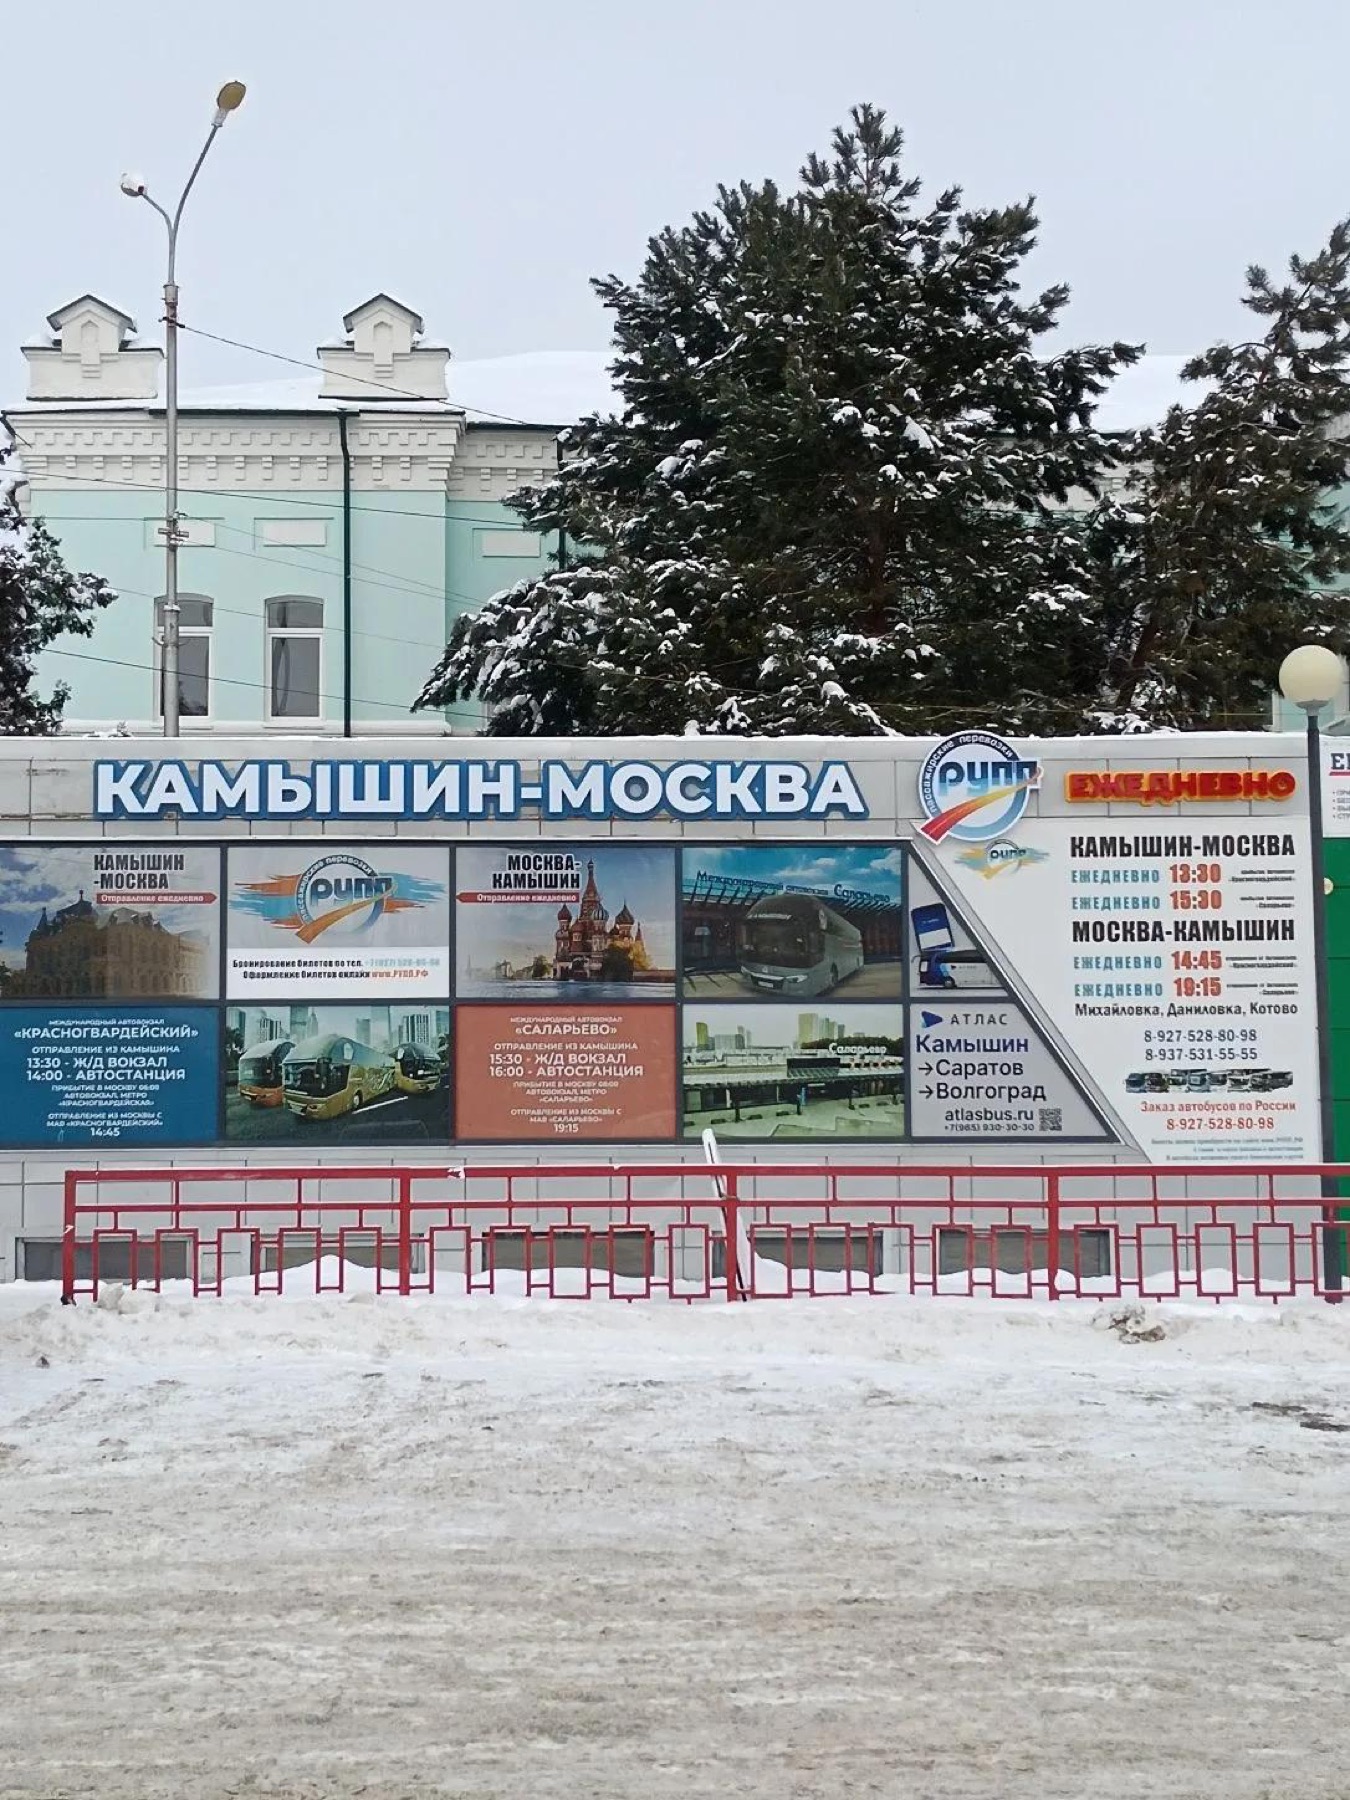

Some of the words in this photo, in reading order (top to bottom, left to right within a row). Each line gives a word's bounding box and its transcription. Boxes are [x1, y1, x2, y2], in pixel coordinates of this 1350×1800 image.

[96, 763, 862, 815] КАМЫШИН-МОСКВА
[1068, 772, 1296, 802] ЕЖЕДНЕВНО
[1070, 835, 1295, 857] КАМЫШИН-МОСКВА
[94, 854, 184, 870] КАМЫШИН
[508, 854, 581, 870] МОСКВА-
[1071, 869, 1160, 884] ЕЖЕДНЕВНО
[1170, 863, 1222, 884] 13:30
[94, 873, 169, 889] -МОСКВА
[492, 873, 580, 889] КАМЫШИН
[1072, 896, 1161, 911] ЕЖЕДНЕВНО
[1170, 890, 1222, 910] 15:30
[1072, 919, 1295, 942] МОСКВА-КАМЫШИН
[233, 959, 297, 969] Бронирование
[297, 959, 333, 967] билетов
[1073, 956, 1162, 971] ЕЖЕДНЕВНО
[1171, 950, 1222, 970] 14:45
[243, 971, 300, 980] Оформление
[301, 971, 337, 979] билетов
[1074, 983, 1163, 998] ЕЖЕДНЕВНО
[1174, 977, 1222, 997] 19:15
[1075, 1003, 1164, 1018] Михайловка,
[1167, 1003, 1246, 1018] Даниловка,
[1250, 1002, 1298, 1015] Котово
[951, 1013, 1008, 1025] АТЛАС
[14, 1025, 199, 1039] «КРАСНОГВАРДЕЙСКИЙ»
[515, 1024, 617, 1036] «САЛАРЬЕВО»
[1144, 1029, 1257, 1042] 8-927-528-80-98
[32, 1046, 103, 1054] ОТПРАВЛЕНИЕ
[494, 1043, 563, 1051] ОТПРАВЛЕНИЕ
[916, 1034, 1029, 1053] Камышин
[490, 1053, 523, 1064] 15:30
[534, 1053, 565, 1065] Ж/Д
[569, 1053, 626, 1064] ВОКЗАЛ
[1145, 1048, 1258, 1060] 8-937-531-55-55
[27, 1057, 61, 1068] 13:30
[73, 1056, 104, 1069] Ж/Д
[108, 1057, 168, 1068] ВОКЗАЛ
[936, 1059, 1024, 1079] Саратов
[26, 1070, 63, 1081] 14:00
[76, 1069, 186, 1081] АВТОСТАНЦИЯ
[490, 1066, 524, 1077] 16:00
[536, 1066, 644, 1078] АВТОСТАНЦИЯ
[937, 1083, 1047, 1103] Волгоград
[1141, 1101, 1175, 1112] Заказ
[1178, 1101, 1236, 1114] автобусов
[1239, 1103, 1252, 1111] по
[1255, 1100, 1296, 1111] России
[945, 1108, 1034, 1121] atlasbus.ru
[554, 1124, 579, 1133] 19:15
[1166, 1117, 1275, 1131] 8-927-528-80-98
[91, 1127, 120, 1137] 14:45
